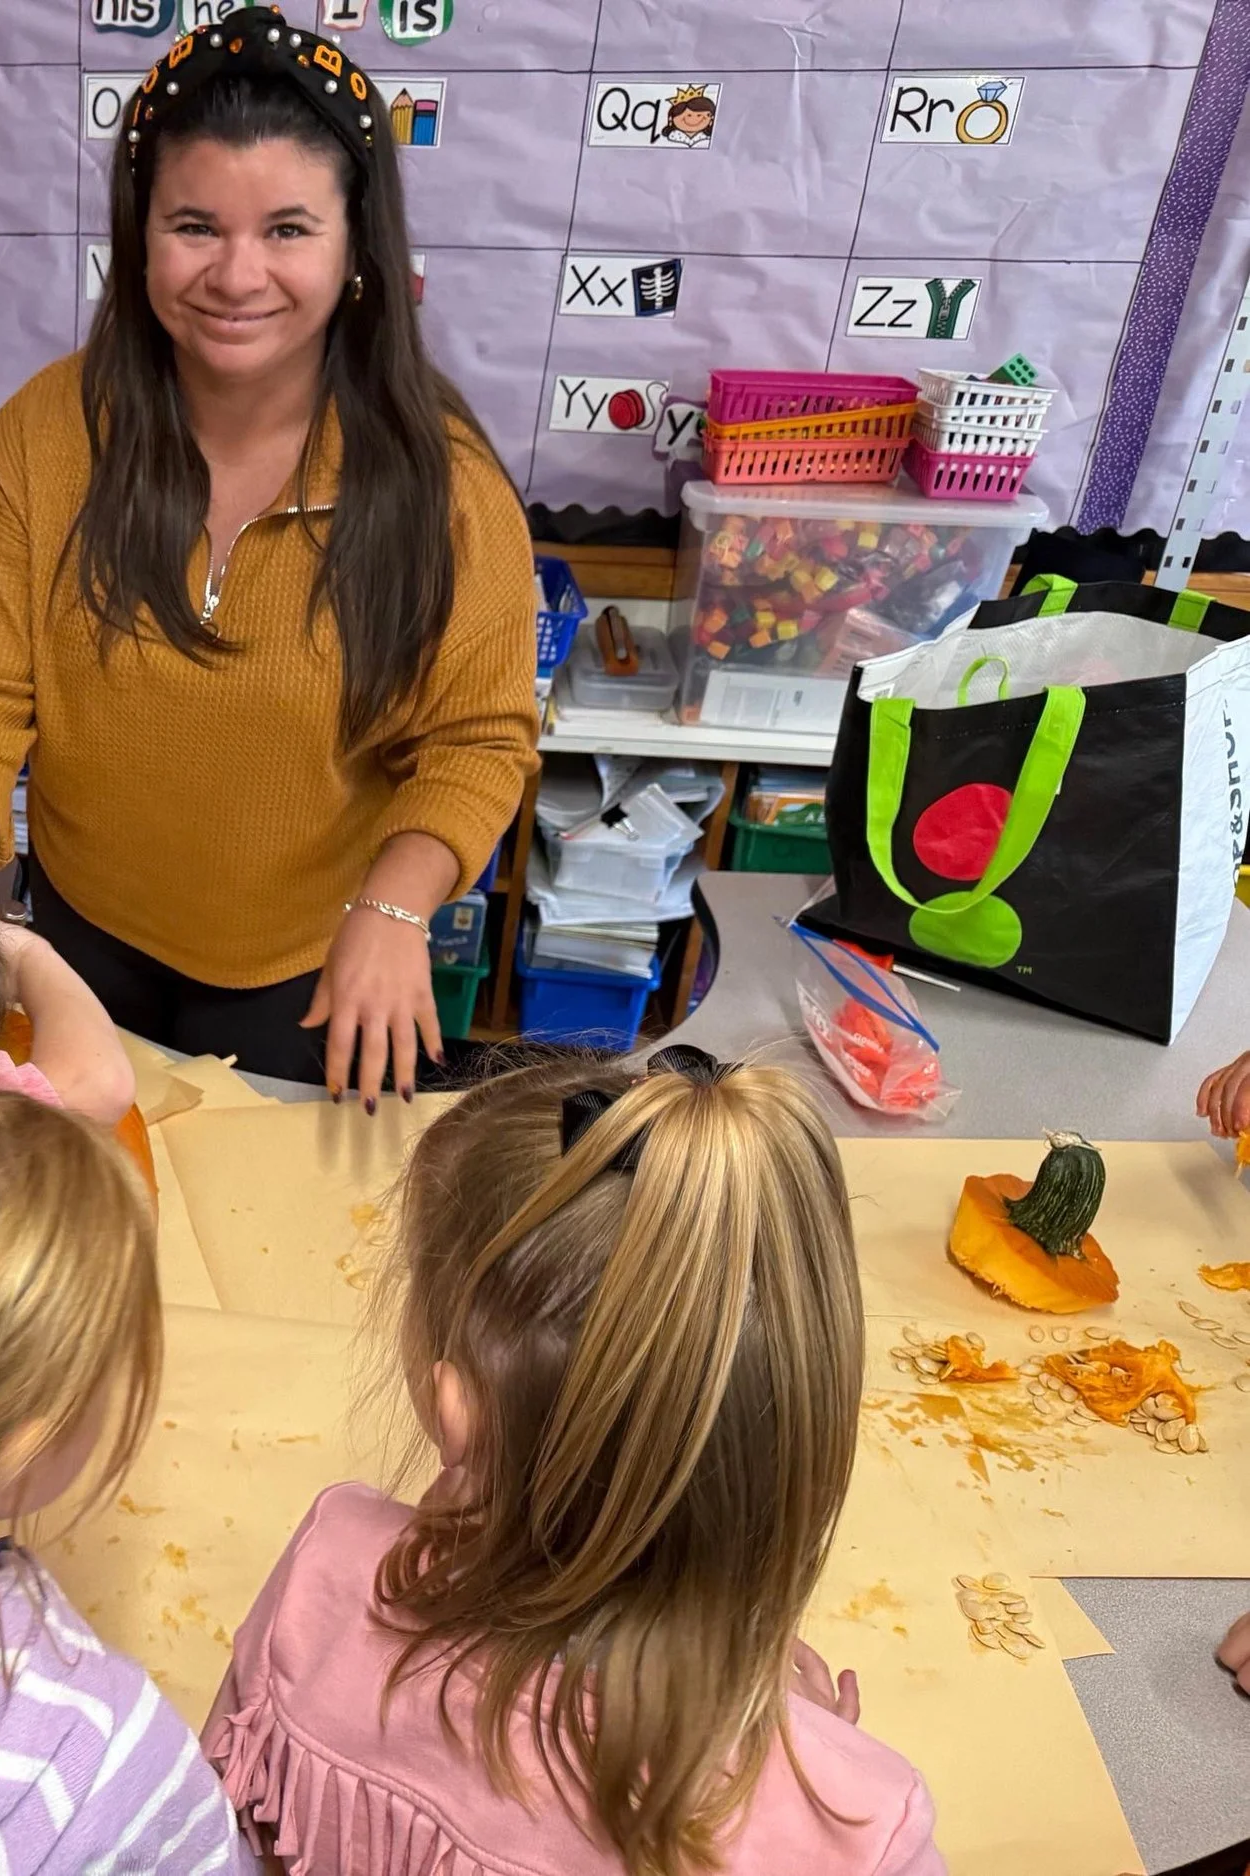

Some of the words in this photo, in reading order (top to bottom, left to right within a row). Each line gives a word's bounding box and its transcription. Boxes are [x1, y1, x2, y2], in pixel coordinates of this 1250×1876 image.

[400, 0, 437, 32] is
[596, 87, 663, 145] Qq
[890, 86, 955, 133] Rr
[566, 265, 627, 307] Xx
[854, 286, 917, 328] Zz
[559, 379, 609, 430] Yy
[1015, 964, 1033, 976] TM
